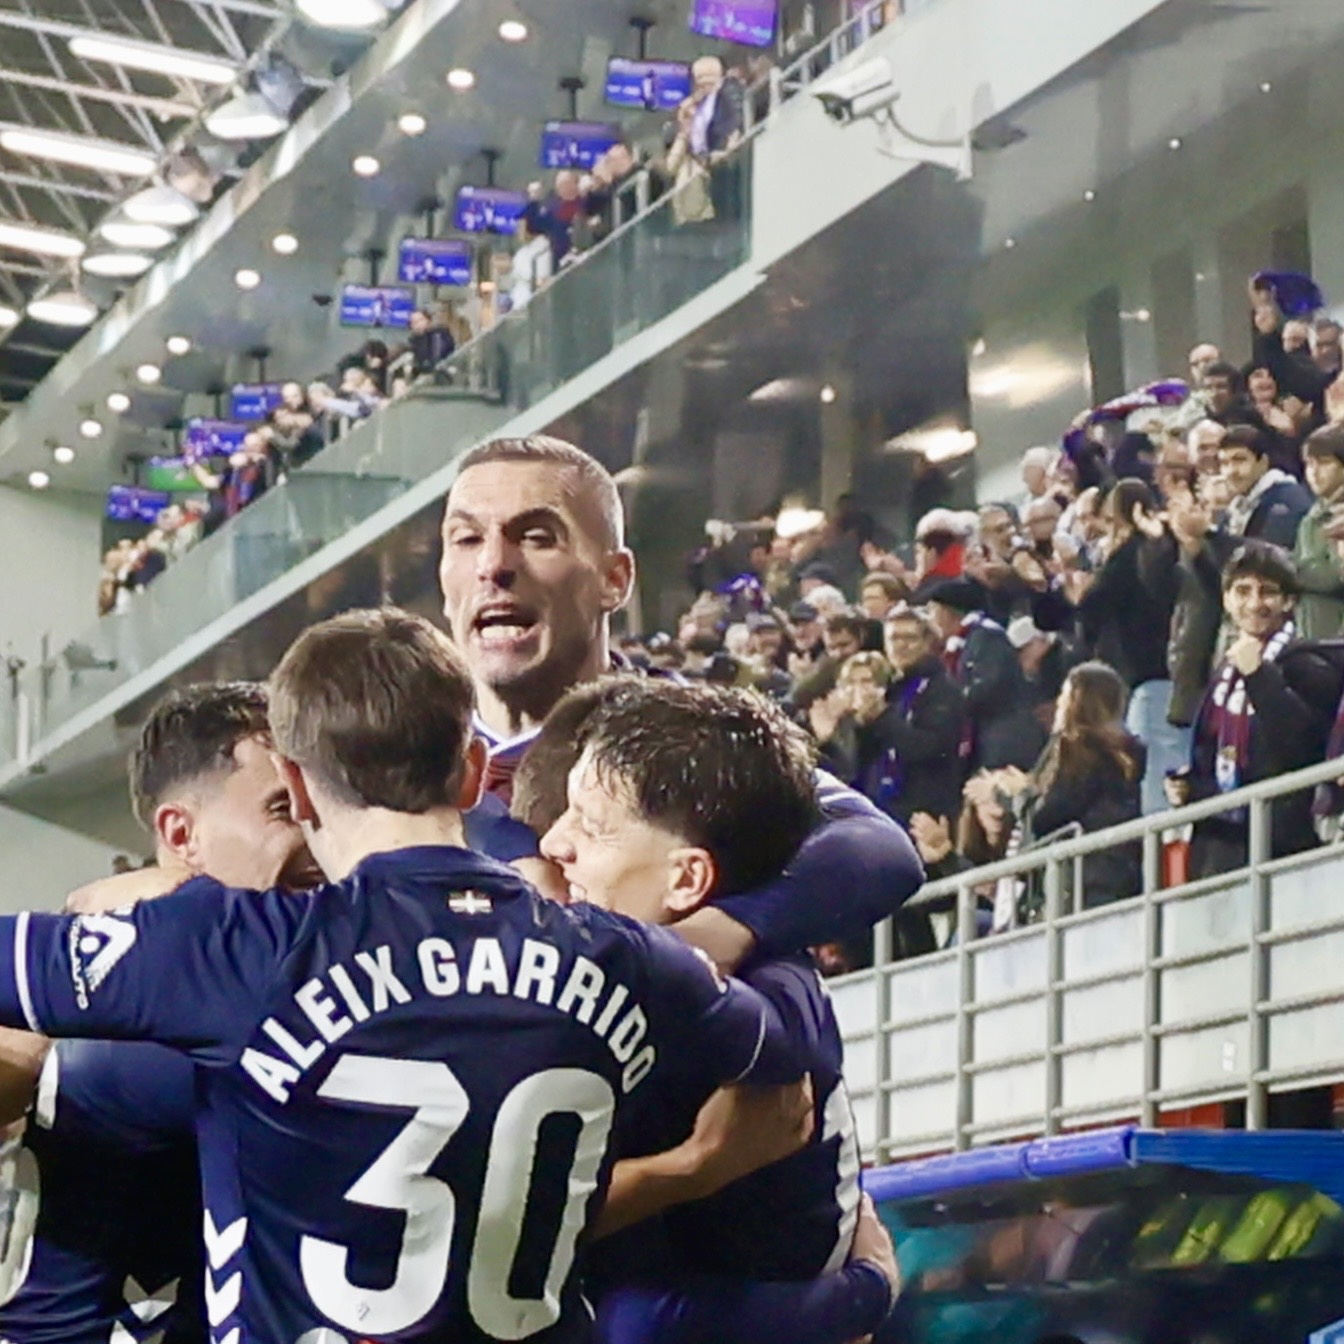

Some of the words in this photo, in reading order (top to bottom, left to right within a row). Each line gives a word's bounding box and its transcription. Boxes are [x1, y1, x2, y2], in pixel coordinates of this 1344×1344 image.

[240, 945, 412, 1104] ALEIX
[417, 937, 657, 1094] GARRIDO
[299, 1053, 616, 1341] 30
